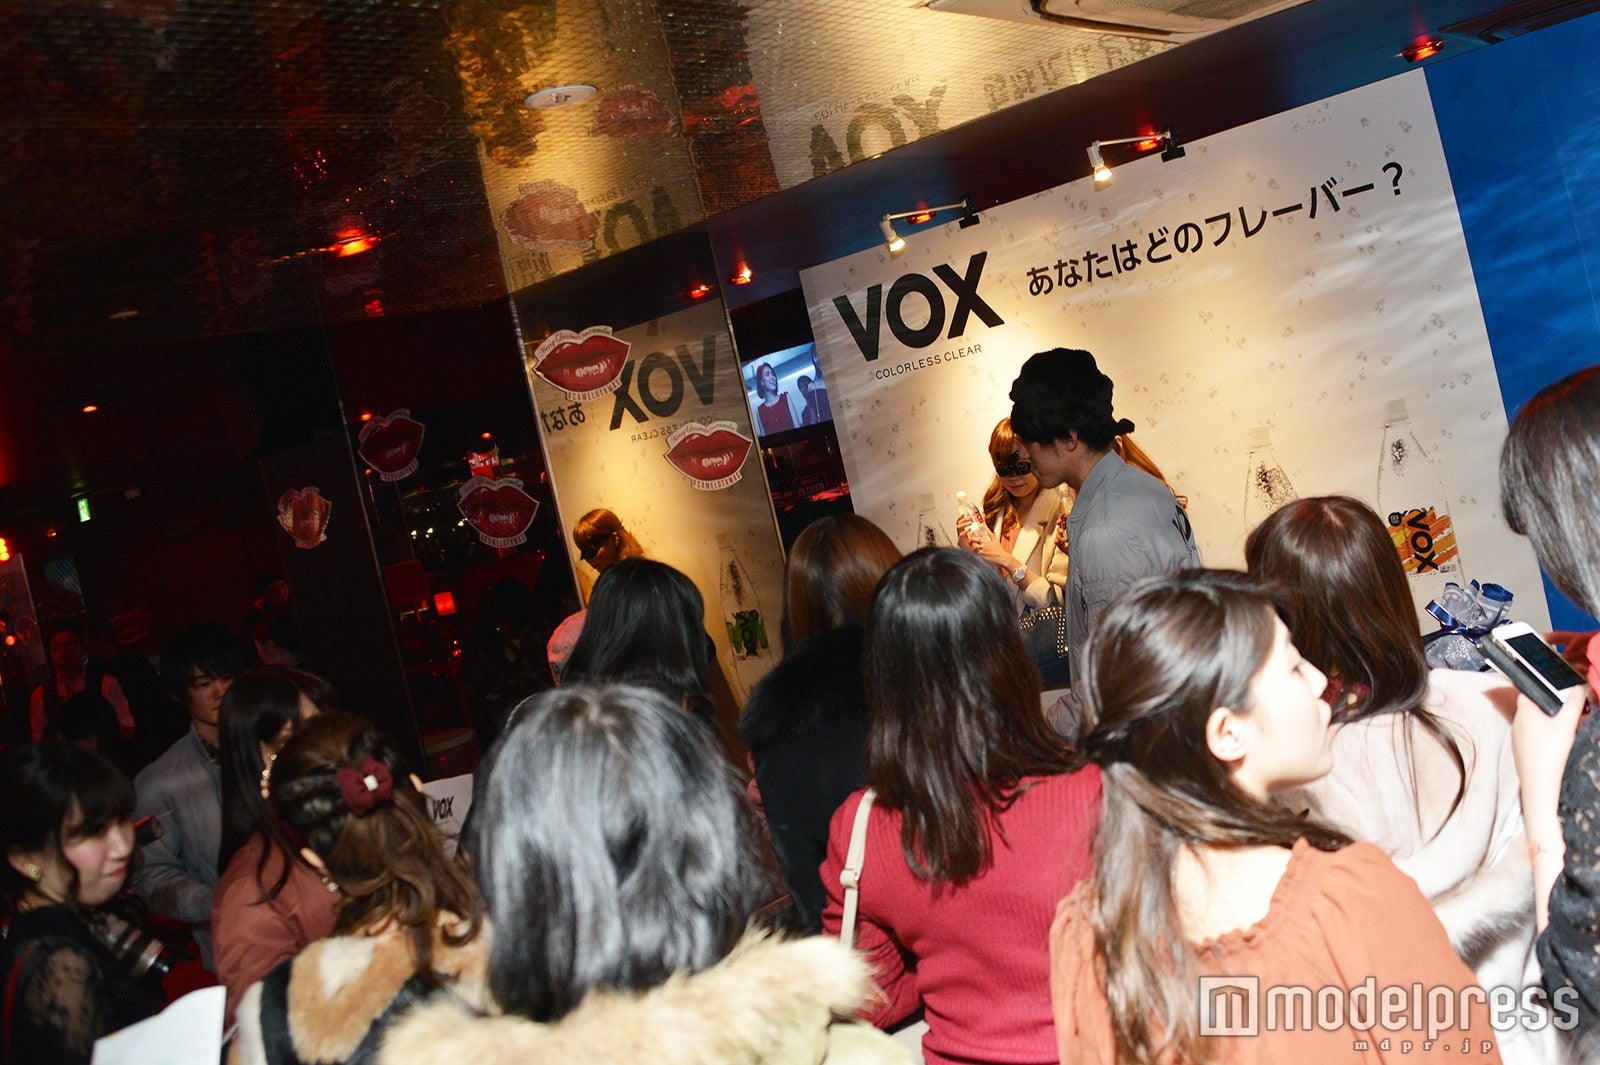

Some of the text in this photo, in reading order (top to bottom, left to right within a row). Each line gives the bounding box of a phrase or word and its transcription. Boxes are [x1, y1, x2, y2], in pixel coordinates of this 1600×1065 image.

[1026, 161, 1404, 298] あなたはどのフレーバー？
[833, 251, 1004, 362] VOX
[875, 343, 982, 380] COLORLESS CLEAR
[1406, 508, 1439, 573] VOX
[432, 796, 454, 822] VOX
